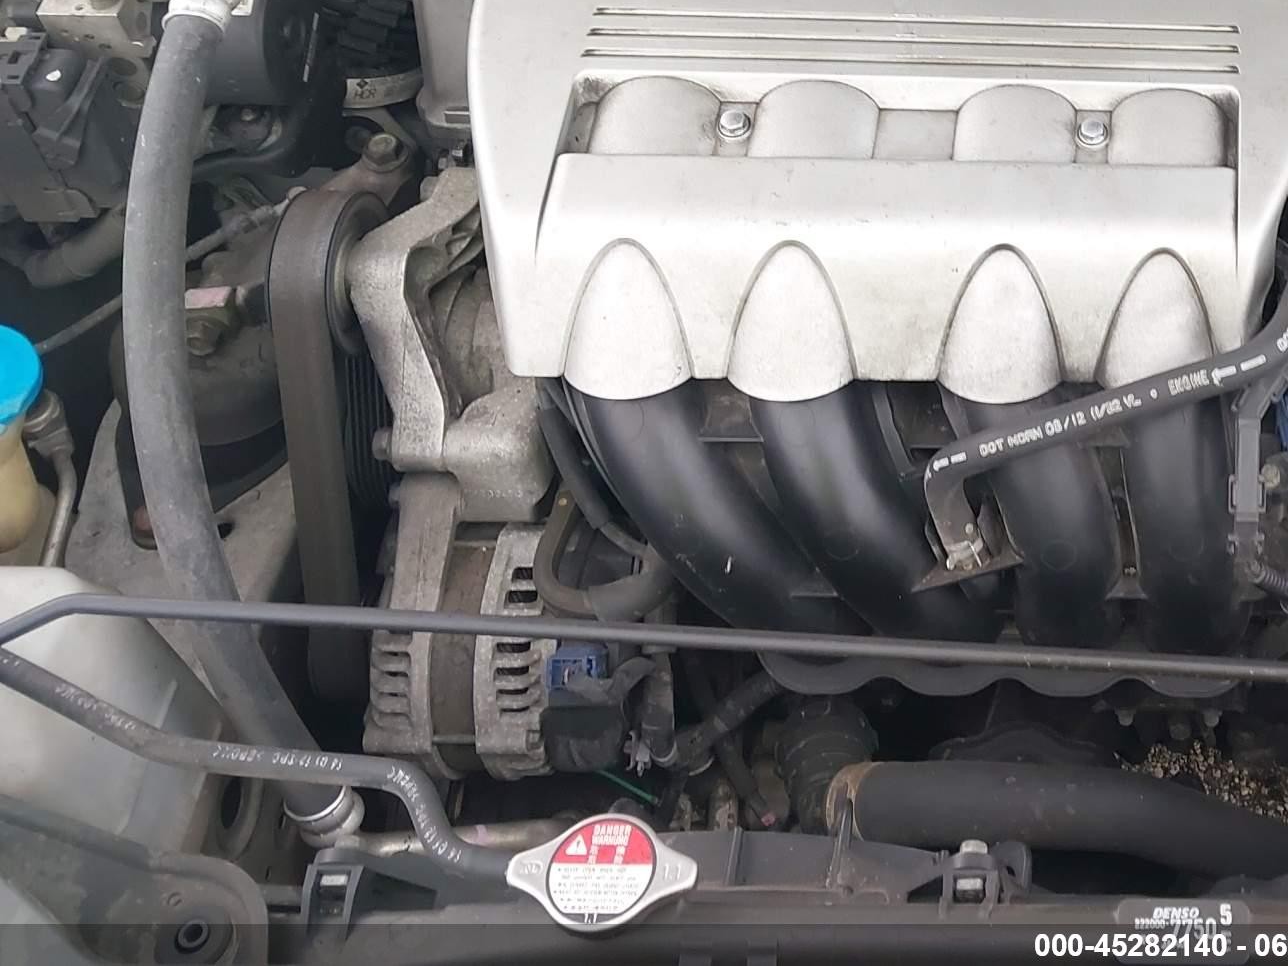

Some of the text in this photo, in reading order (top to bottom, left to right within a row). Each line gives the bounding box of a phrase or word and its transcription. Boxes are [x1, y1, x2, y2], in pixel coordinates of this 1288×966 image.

[978, 438, 1004, 458] DOT
[592, 824, 632, 836] DANGER
[1152, 906, 1200, 920] DENSO
[1220, 903, 1233, 926] 5
